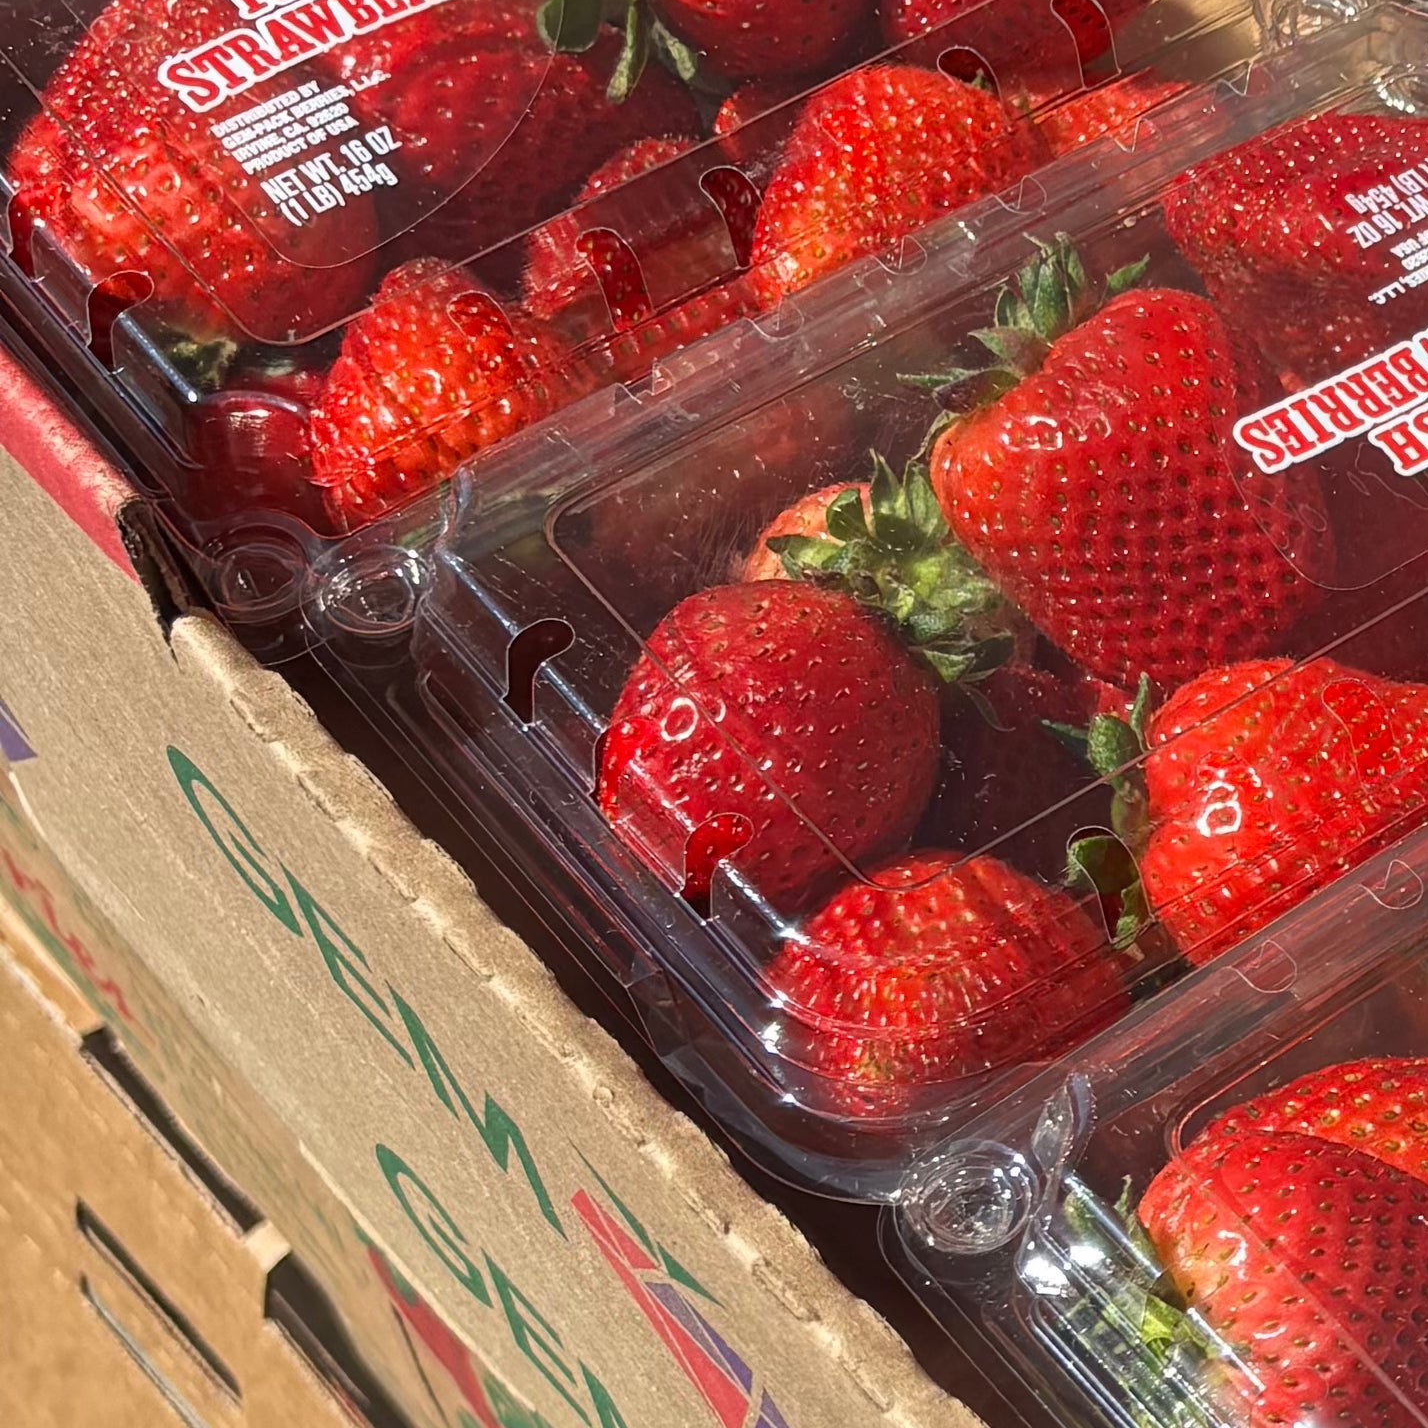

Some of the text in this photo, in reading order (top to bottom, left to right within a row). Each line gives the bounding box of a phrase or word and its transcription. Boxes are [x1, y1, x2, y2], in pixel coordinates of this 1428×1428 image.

[258, 124, 404, 203] NET WT. 16 OZ
[300, 179, 346, 215] LB)
[334, 156, 399, 201] 454g
[1343, 177, 1402, 219] 454g
[1370, 208, 1405, 237] 16
[1344, 219, 1384, 250] OZ
[166, 745, 568, 1241] GEM
